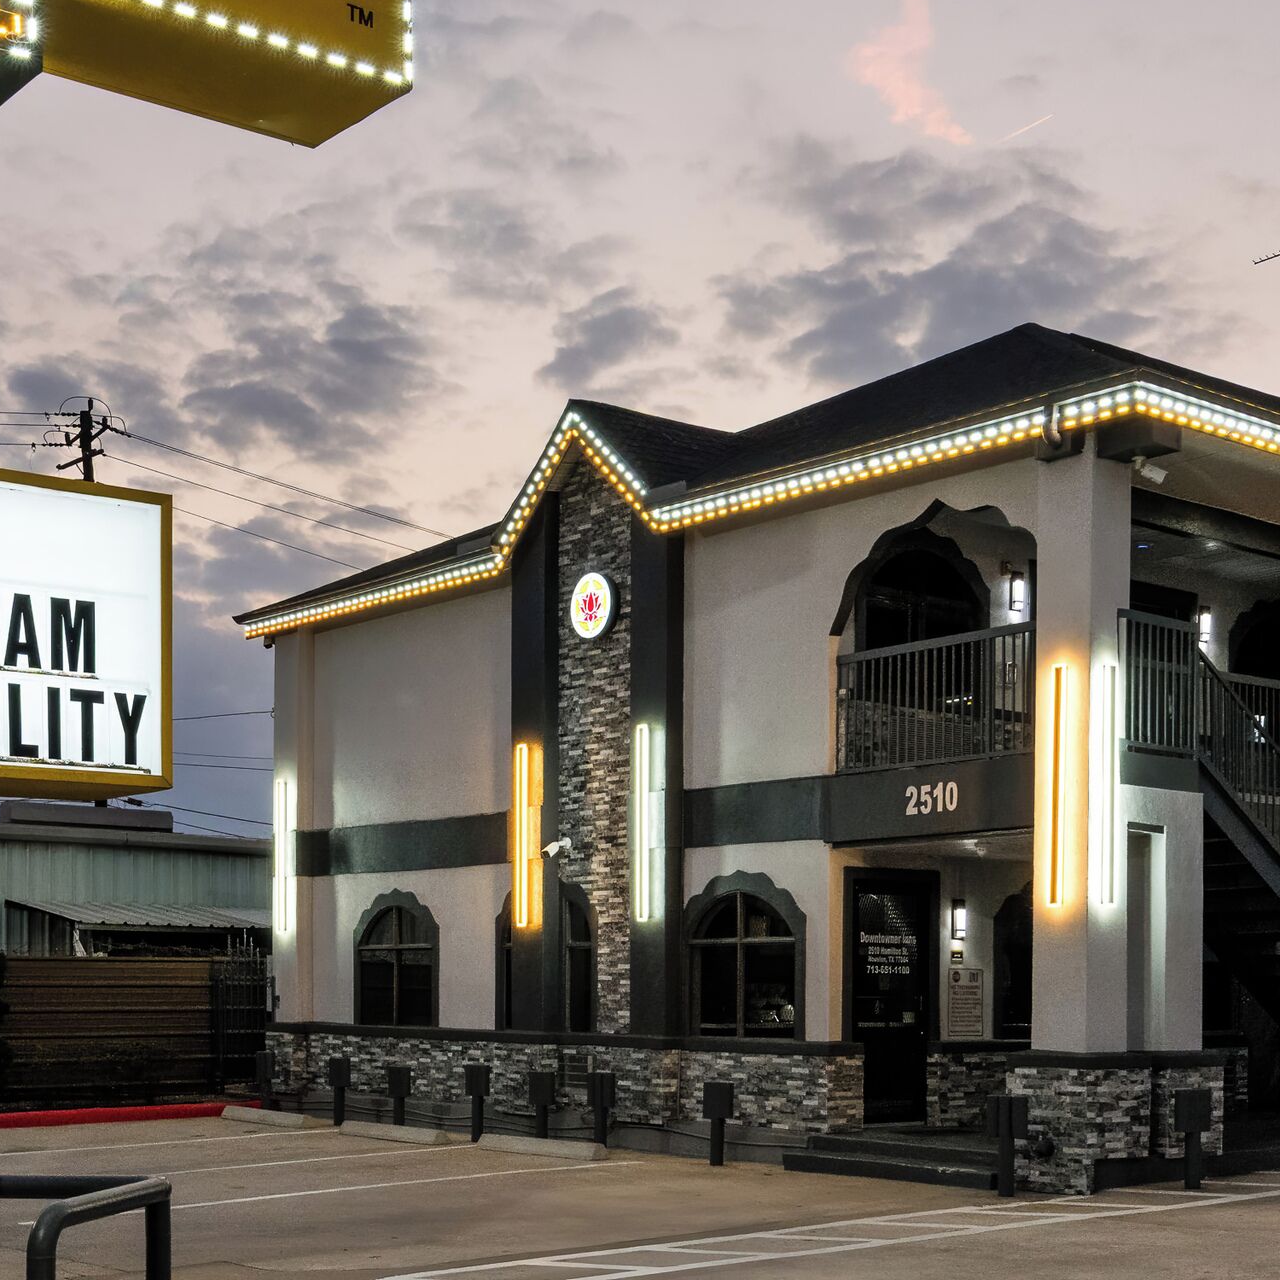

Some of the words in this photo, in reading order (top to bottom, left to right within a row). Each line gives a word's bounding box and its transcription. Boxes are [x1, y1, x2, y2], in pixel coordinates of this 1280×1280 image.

[347, 3, 374, 29] TM
[906, 782, 958, 816] 2510
[860, 931, 901, 944] Downtowner
